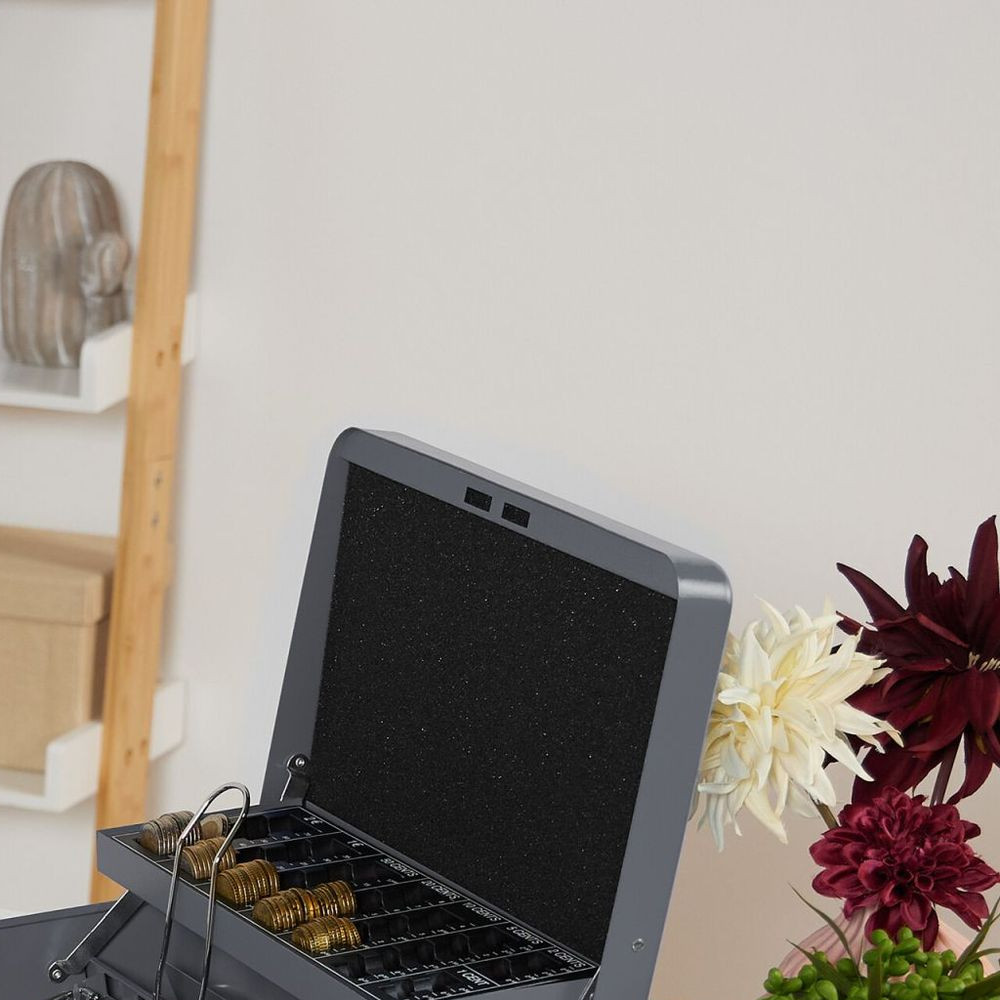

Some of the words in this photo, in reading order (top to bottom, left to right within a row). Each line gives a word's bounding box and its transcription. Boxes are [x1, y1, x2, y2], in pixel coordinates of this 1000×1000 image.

[390, 863, 418, 877] CENTS
[431, 885, 460, 899] CENTS
[471, 907, 502, 922] CENTS
[513, 929, 544, 945] CENTS
[554, 951, 586, 968] CENTS
[462, 972, 490, 986] CENT
